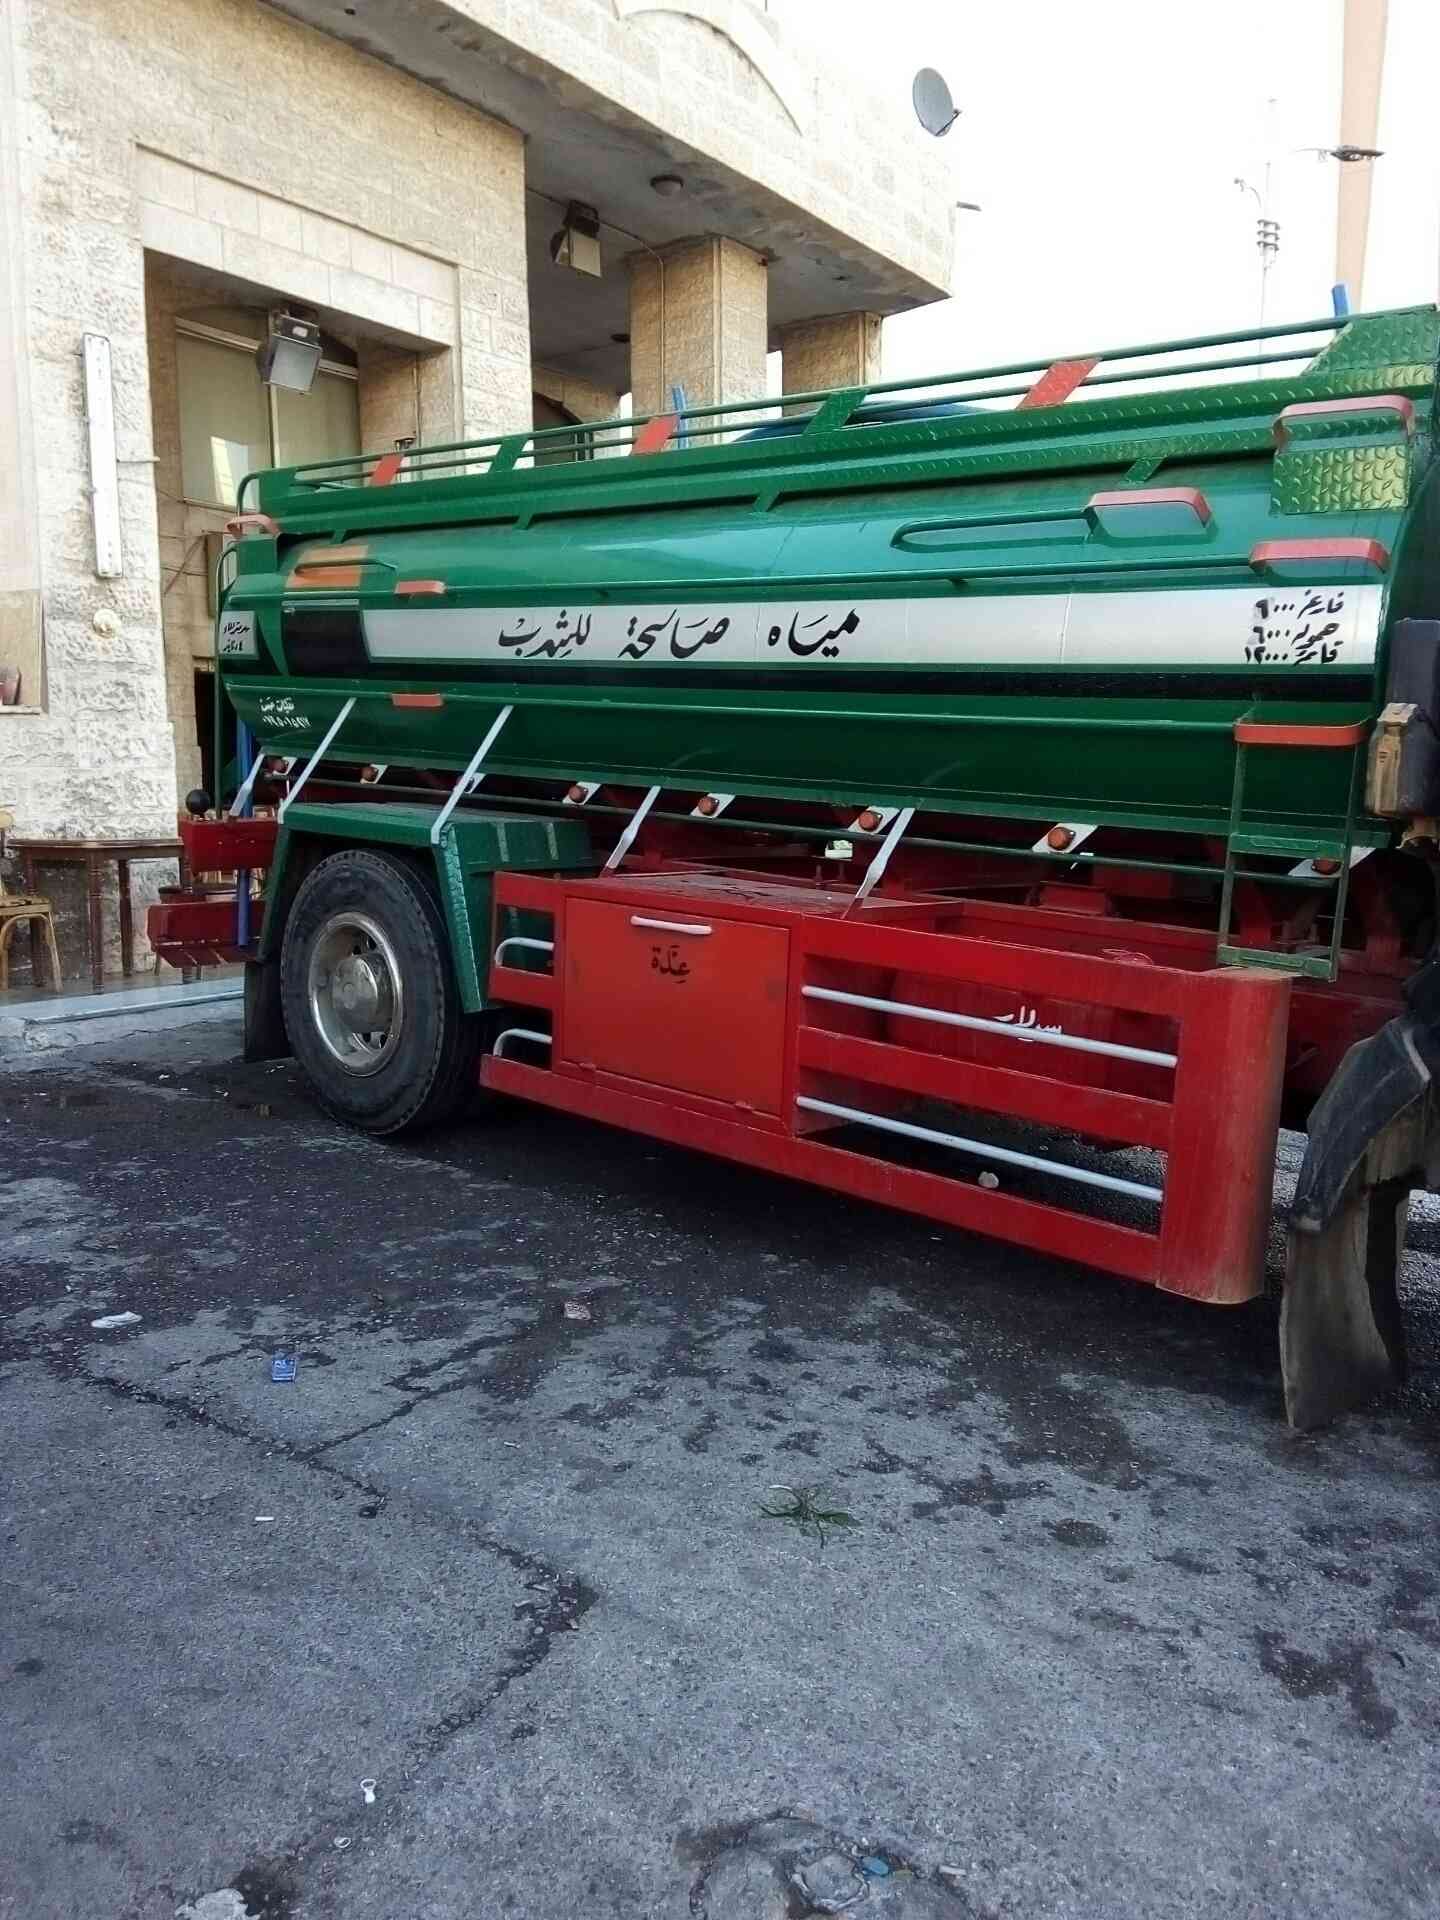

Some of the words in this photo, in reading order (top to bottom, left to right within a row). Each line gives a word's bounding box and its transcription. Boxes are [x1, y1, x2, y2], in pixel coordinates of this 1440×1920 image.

[1297, 589, 1344, 619] فارغ
[498, 609, 592, 658] للشرب
[617, 608, 730, 659] صالحة
[767, 608, 861, 657] مياه
